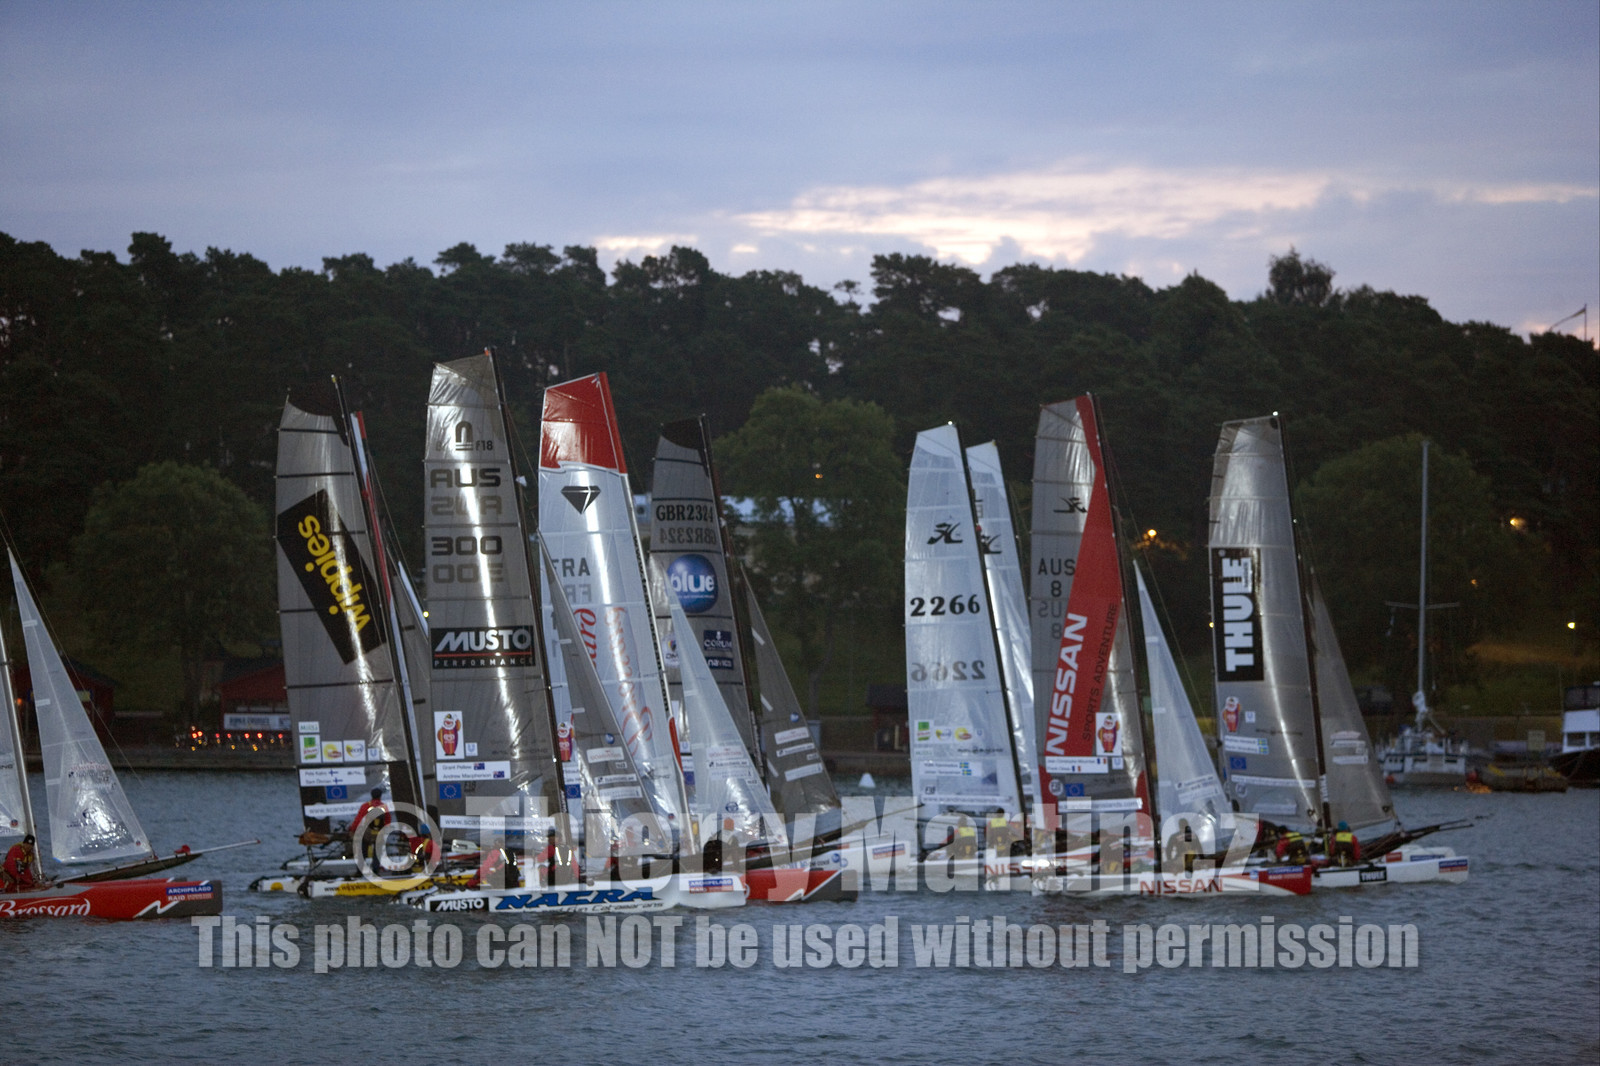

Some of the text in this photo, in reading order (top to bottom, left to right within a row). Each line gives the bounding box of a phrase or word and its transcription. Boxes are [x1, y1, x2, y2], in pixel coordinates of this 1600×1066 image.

[430, 468, 502, 488] AUS
[656, 504, 714, 522] GBR2324
[431, 535, 503, 556] 300
[298, 515, 371, 632] wippies
[1038, 558, 1075, 576] AUS
[671, 571, 715, 593] blue
[1051, 580, 1062, 597] 8
[910, 594, 981, 617] 2266
[1222, 557, 1254, 672] THULE
[434, 629, 532, 652] MUSTO
[434, 658, 532, 667] PERFORMANCE
[1083, 603, 1117, 741] SPORTS ADVENTURE
[1046, 613, 1088, 755] NISSAN
[1361, 870, 1386, 882] THULE
[168, 886, 212, 894] ARCHIPELAGO
[1139, 879, 1224, 895] NISSAN
[435, 898, 484, 911] MUSTO
